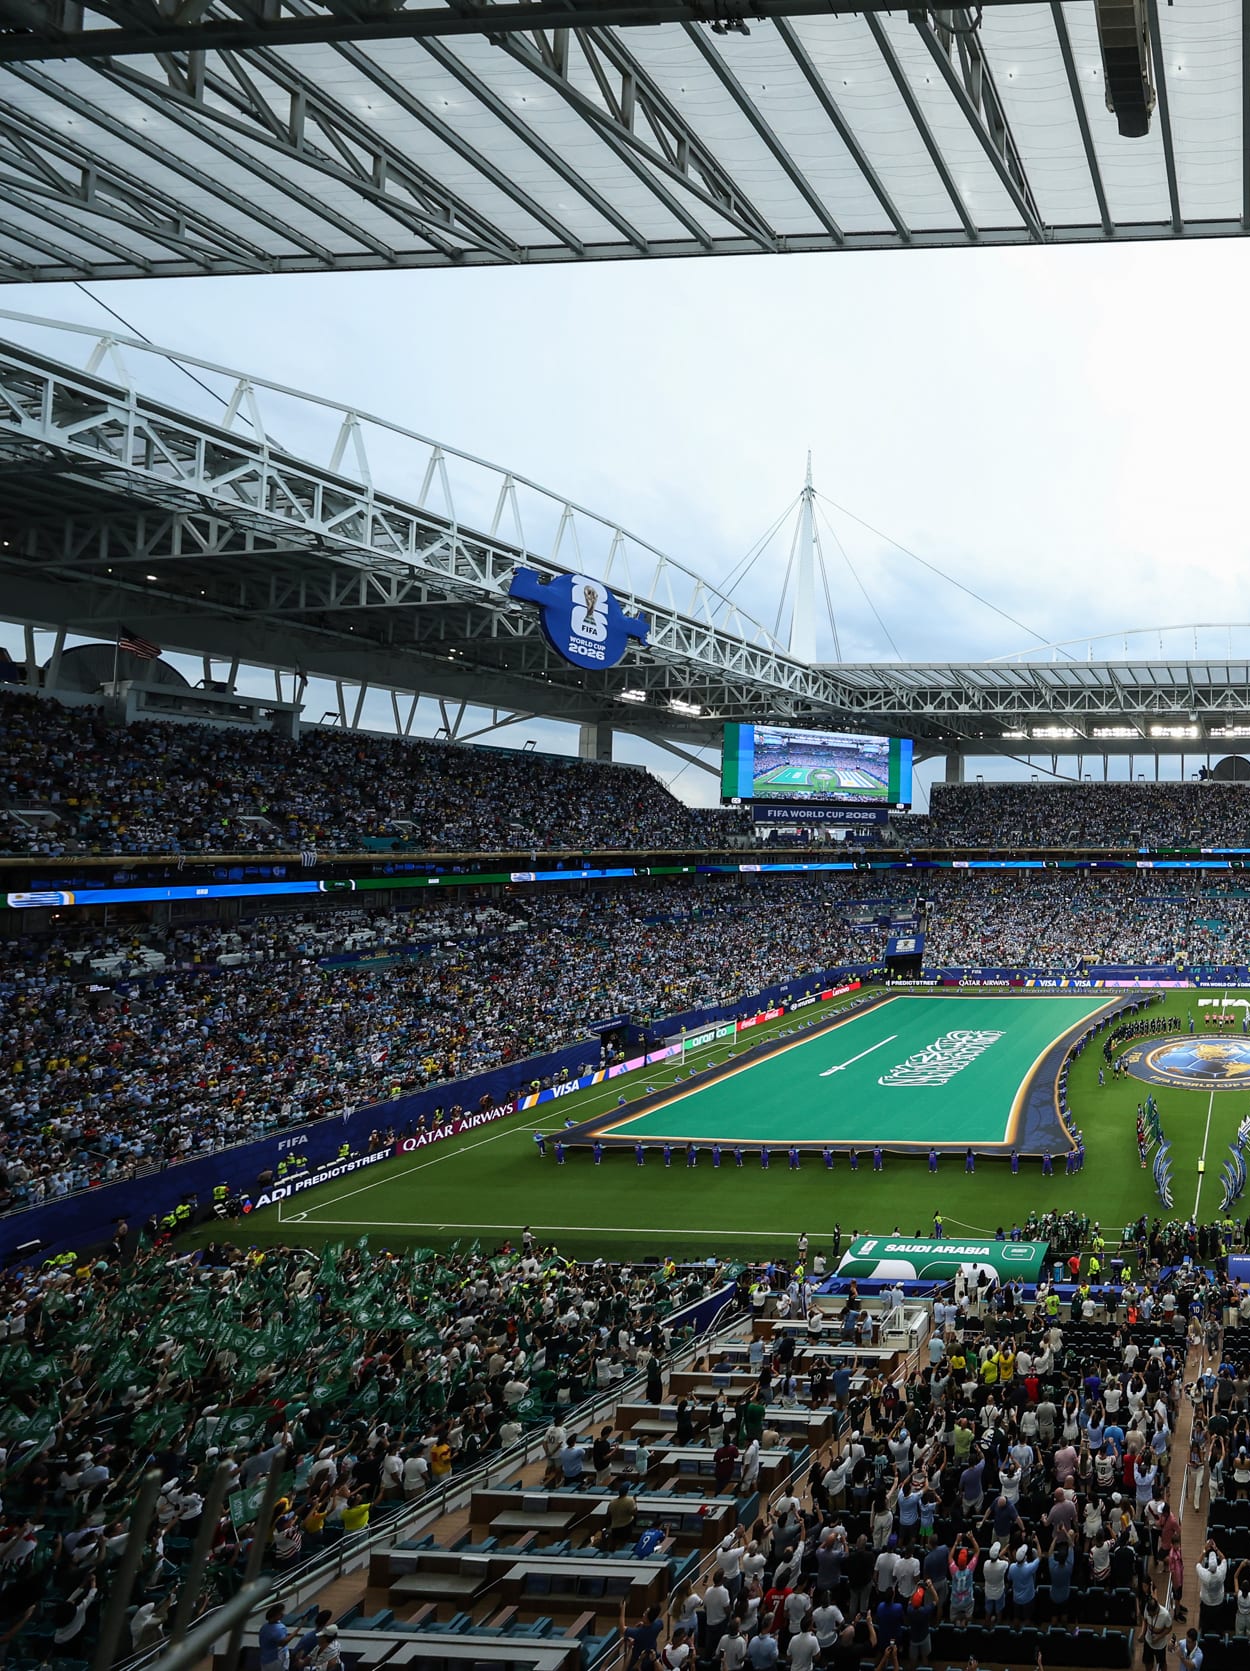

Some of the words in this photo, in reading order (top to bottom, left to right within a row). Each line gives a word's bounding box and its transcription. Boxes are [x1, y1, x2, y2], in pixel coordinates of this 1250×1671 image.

[581, 624, 598, 636] FIFA
[570, 636, 592, 648] WORLD
[593, 642, 606, 651] CUP
[568, 643, 606, 660] 2026
[767, 810, 789, 818] FIFA
[790, 810, 825, 818] WORLD
[826, 811, 845, 819] CUP
[846, 811, 877, 820] 2026
[1198, 998, 1250, 1007] FIFA
[550, 1079, 580, 1098] VISA
[402, 1124, 454, 1152] QATAR
[459, 1102, 514, 1132] AIRWAYS
[278, 1134, 308, 1150] FIFA
[255, 1184, 291, 1209] ADI
[295, 1148, 392, 1192] PREDICTSTREET
[884, 1244, 930, 1253] SAUDI
[932, 1246, 990, 1256] ARABIA
[642, 1536, 650, 1549] 9
